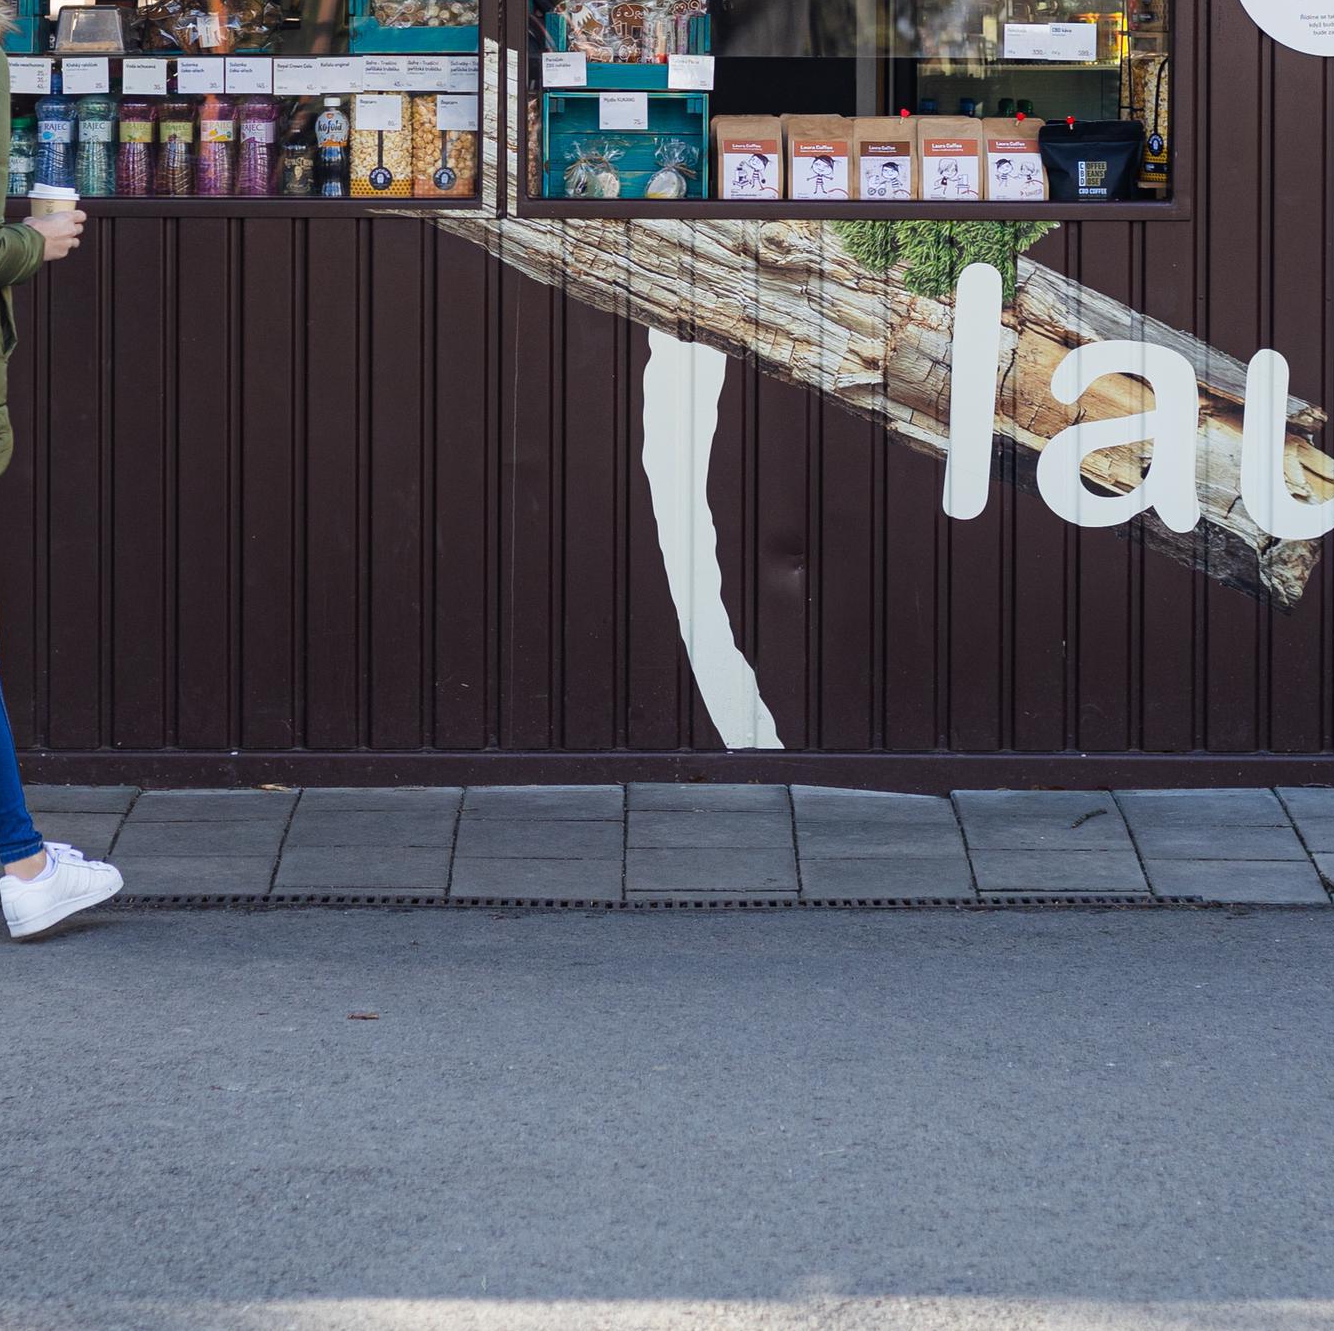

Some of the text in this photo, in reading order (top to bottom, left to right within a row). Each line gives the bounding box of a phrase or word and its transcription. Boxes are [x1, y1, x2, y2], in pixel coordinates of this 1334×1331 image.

[44, 122, 68, 131] RAJEC
[83, 121, 105, 130] RAJEC
[318, 119, 343, 134] kofola
